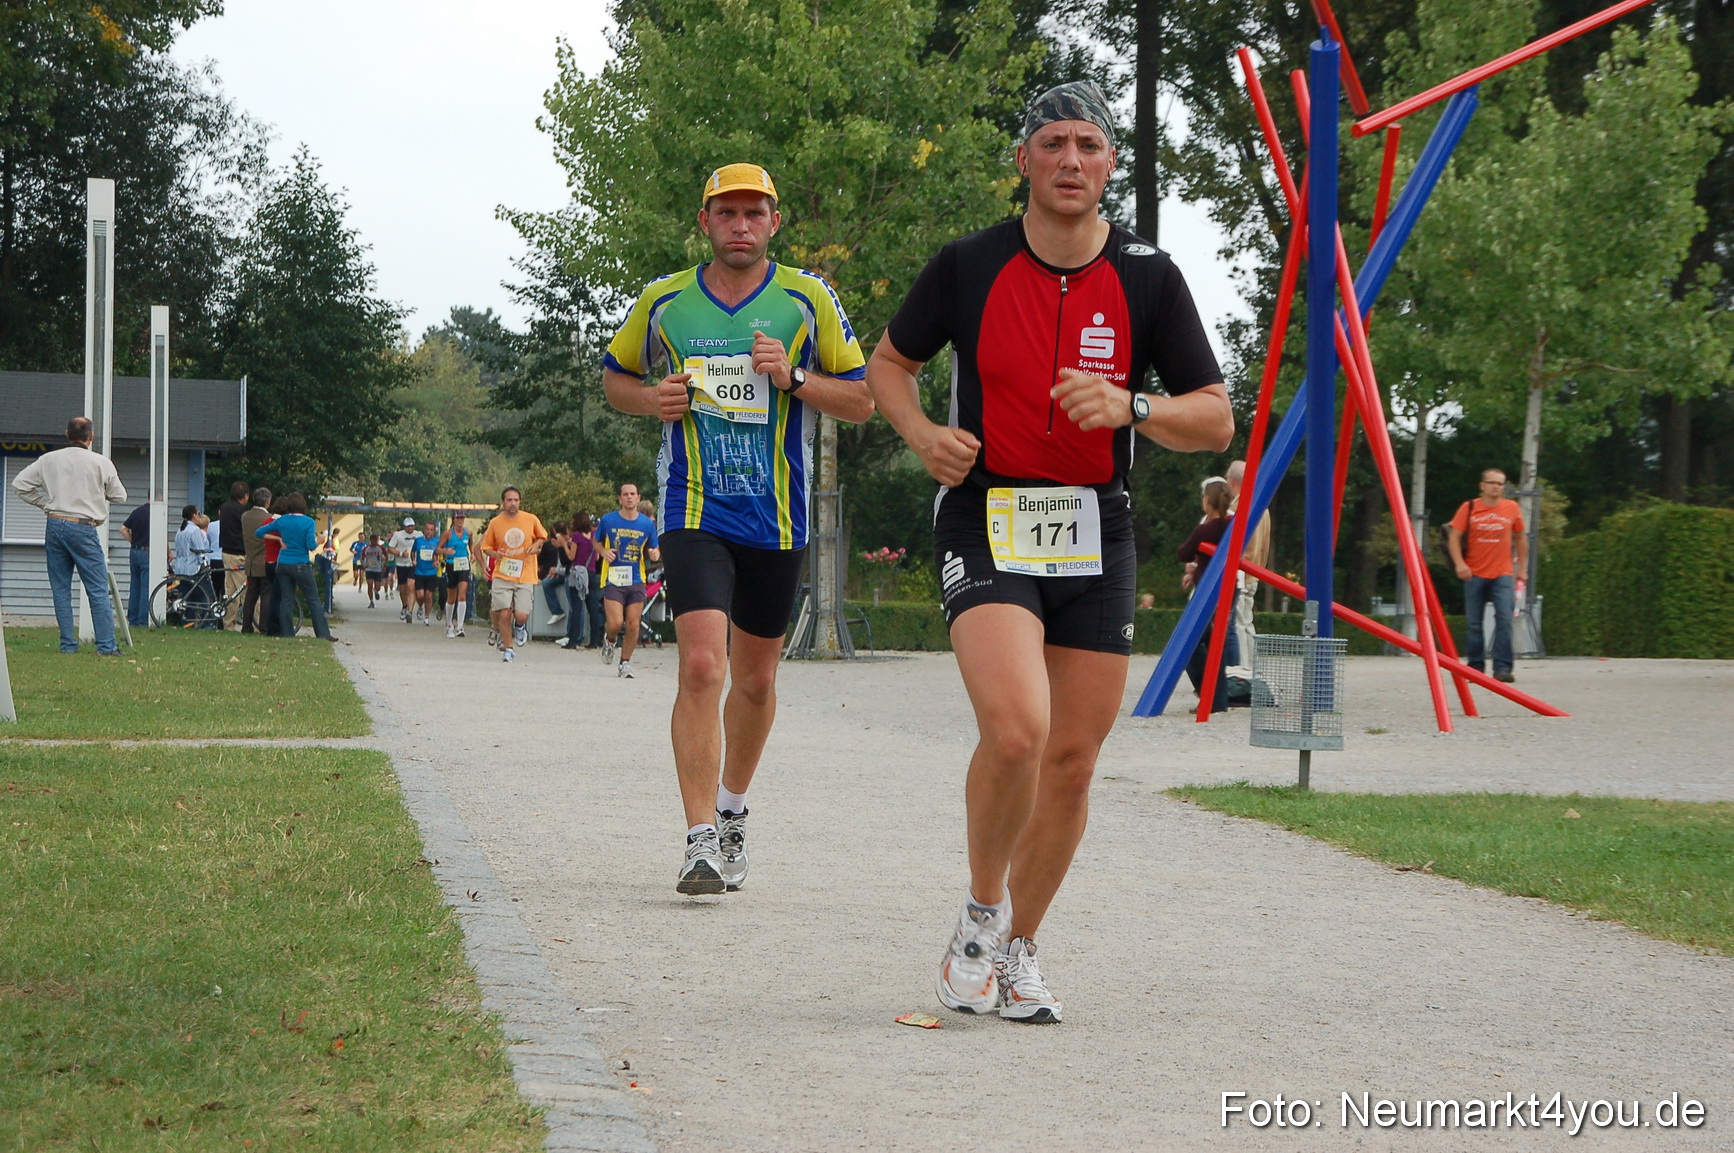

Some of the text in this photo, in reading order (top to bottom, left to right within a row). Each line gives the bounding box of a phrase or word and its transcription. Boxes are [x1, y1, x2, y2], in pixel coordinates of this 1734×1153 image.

[688, 338, 728, 348] TEAM
[707, 363, 745, 377] Helmut
[1078, 359, 1115, 370] Sparkasse
[716, 383, 756, 402] 608
[735, 411, 767, 420] PFLEIDERER
[1018, 495, 1082, 515] Benjamin
[992, 521, 999, 534] C
[1030, 520, 1078, 547] 171
[1058, 560, 1100, 571] PFLEIDERER
